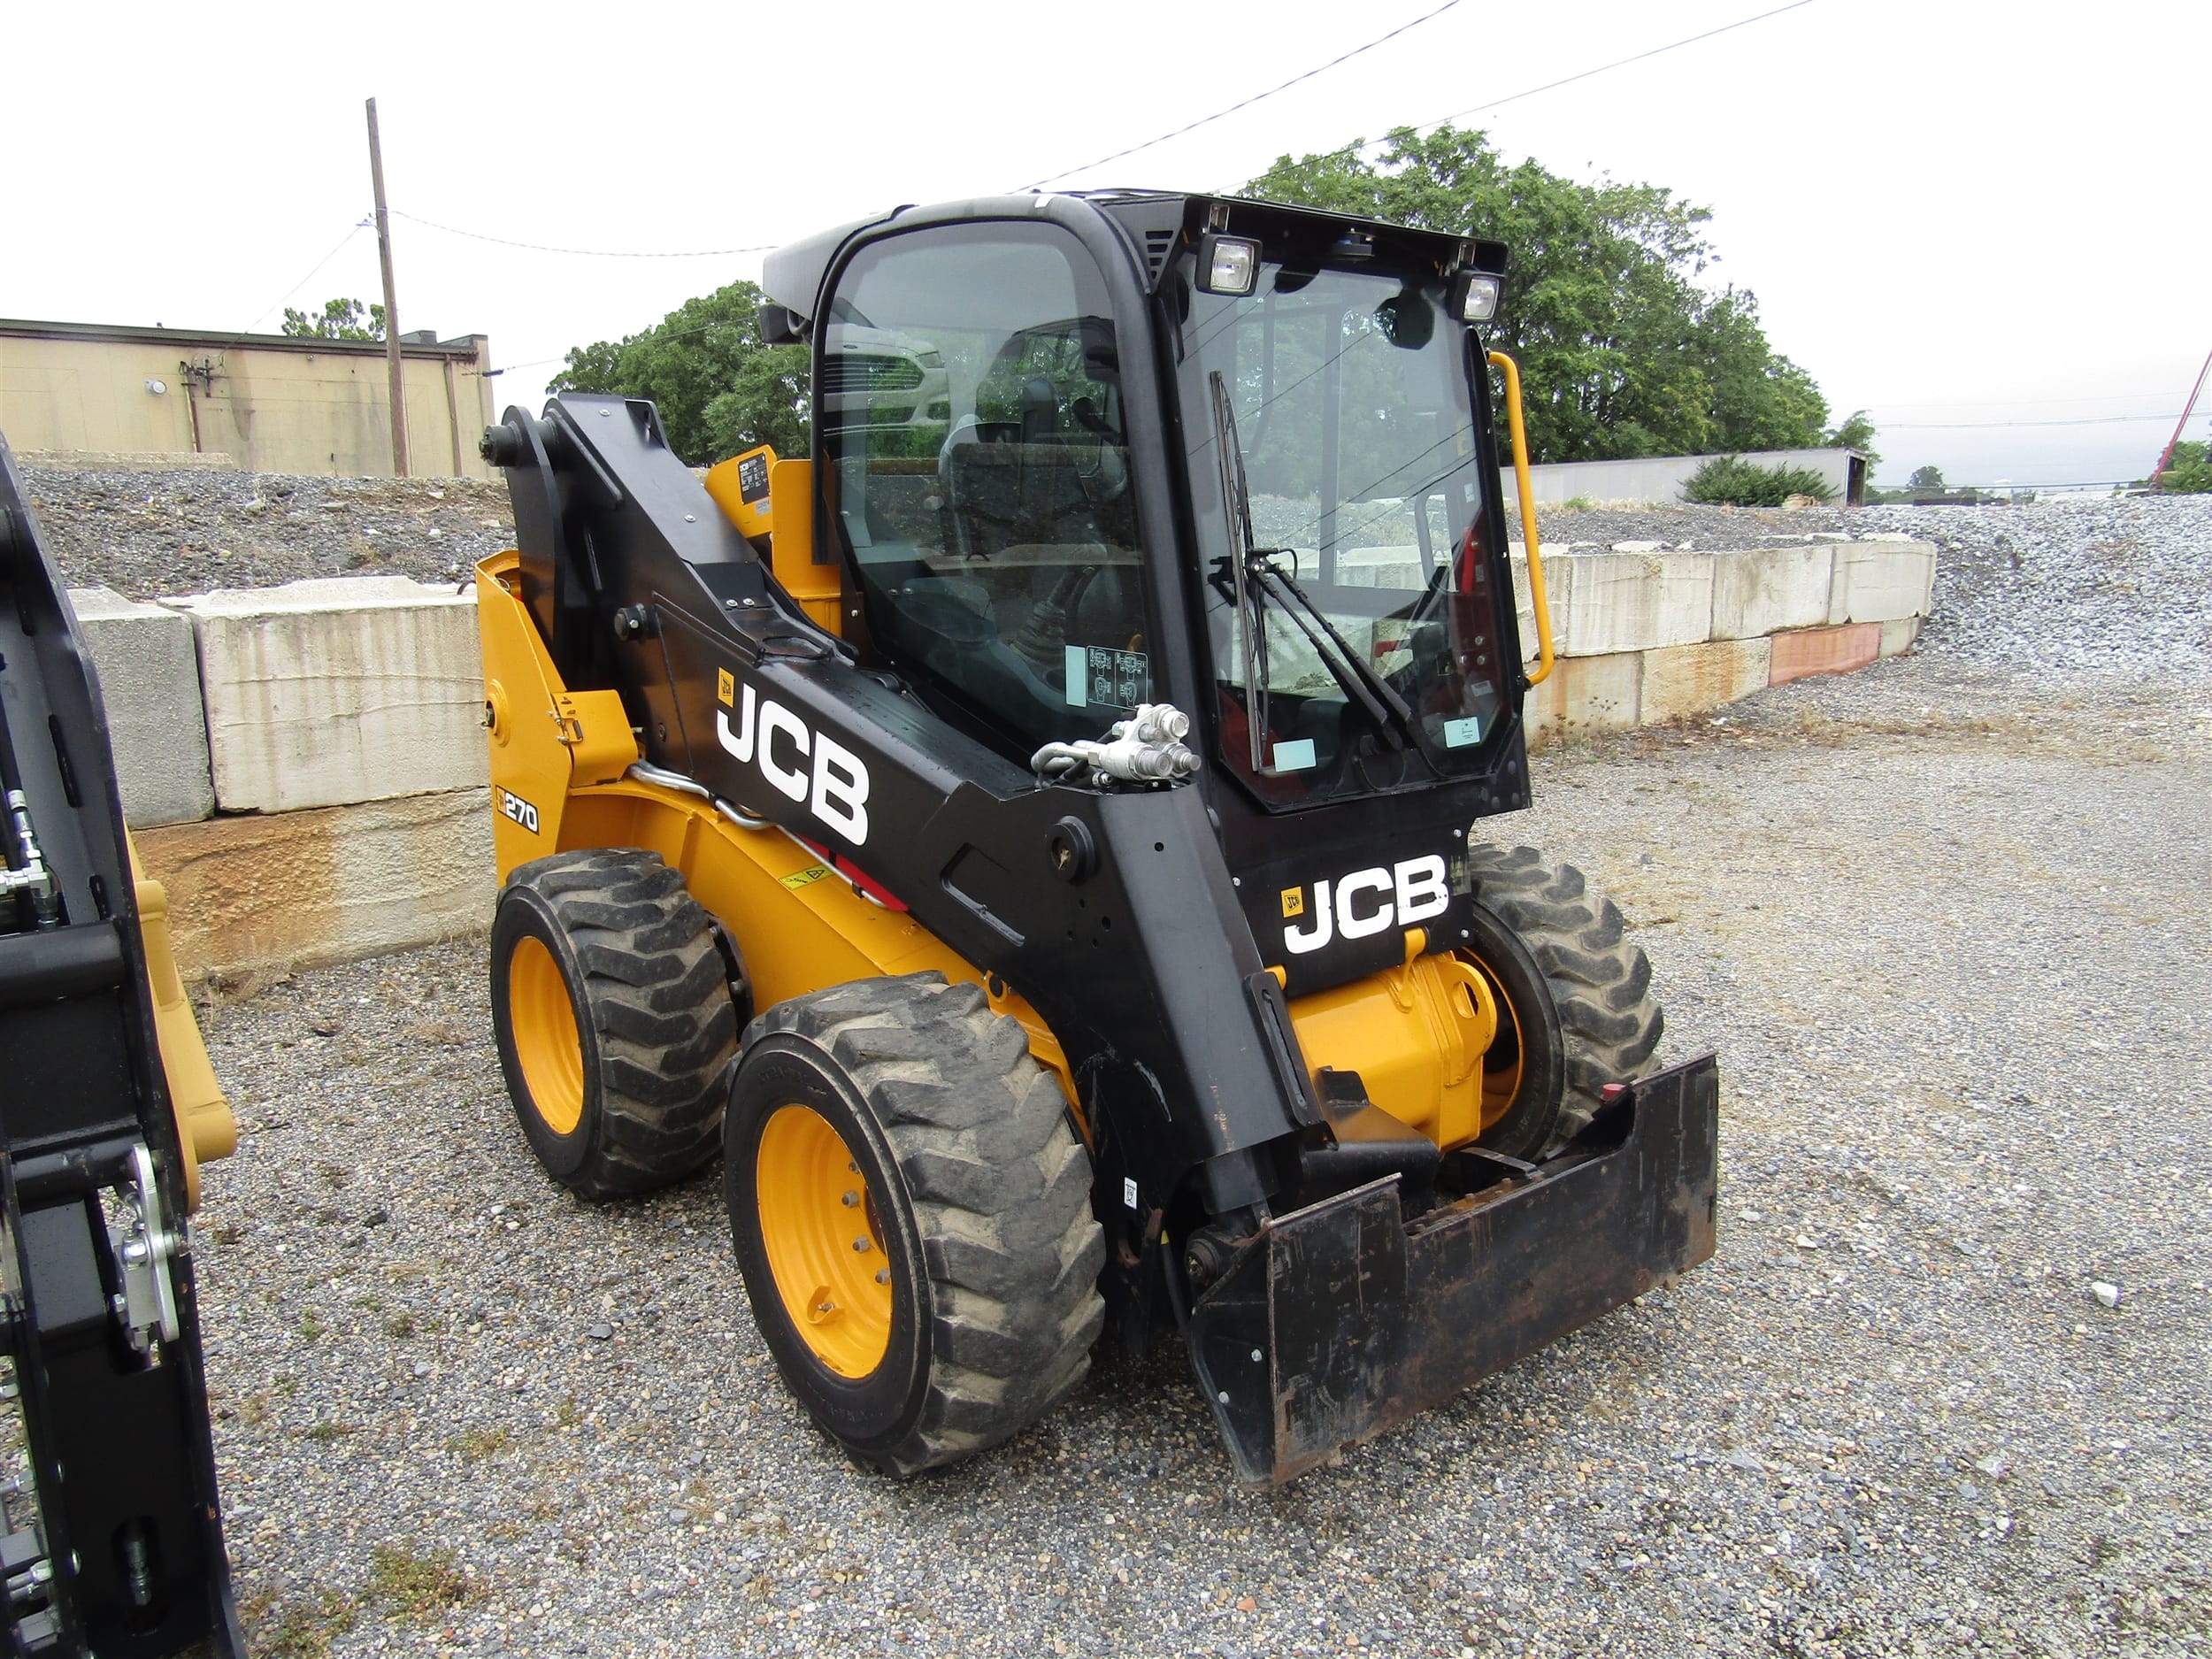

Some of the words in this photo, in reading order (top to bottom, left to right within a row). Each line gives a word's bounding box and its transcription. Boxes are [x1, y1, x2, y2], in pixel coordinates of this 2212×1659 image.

[505, 792, 538, 833] 270
[716, 682, 870, 846] JCB
[1283, 854, 1449, 955] JCB
